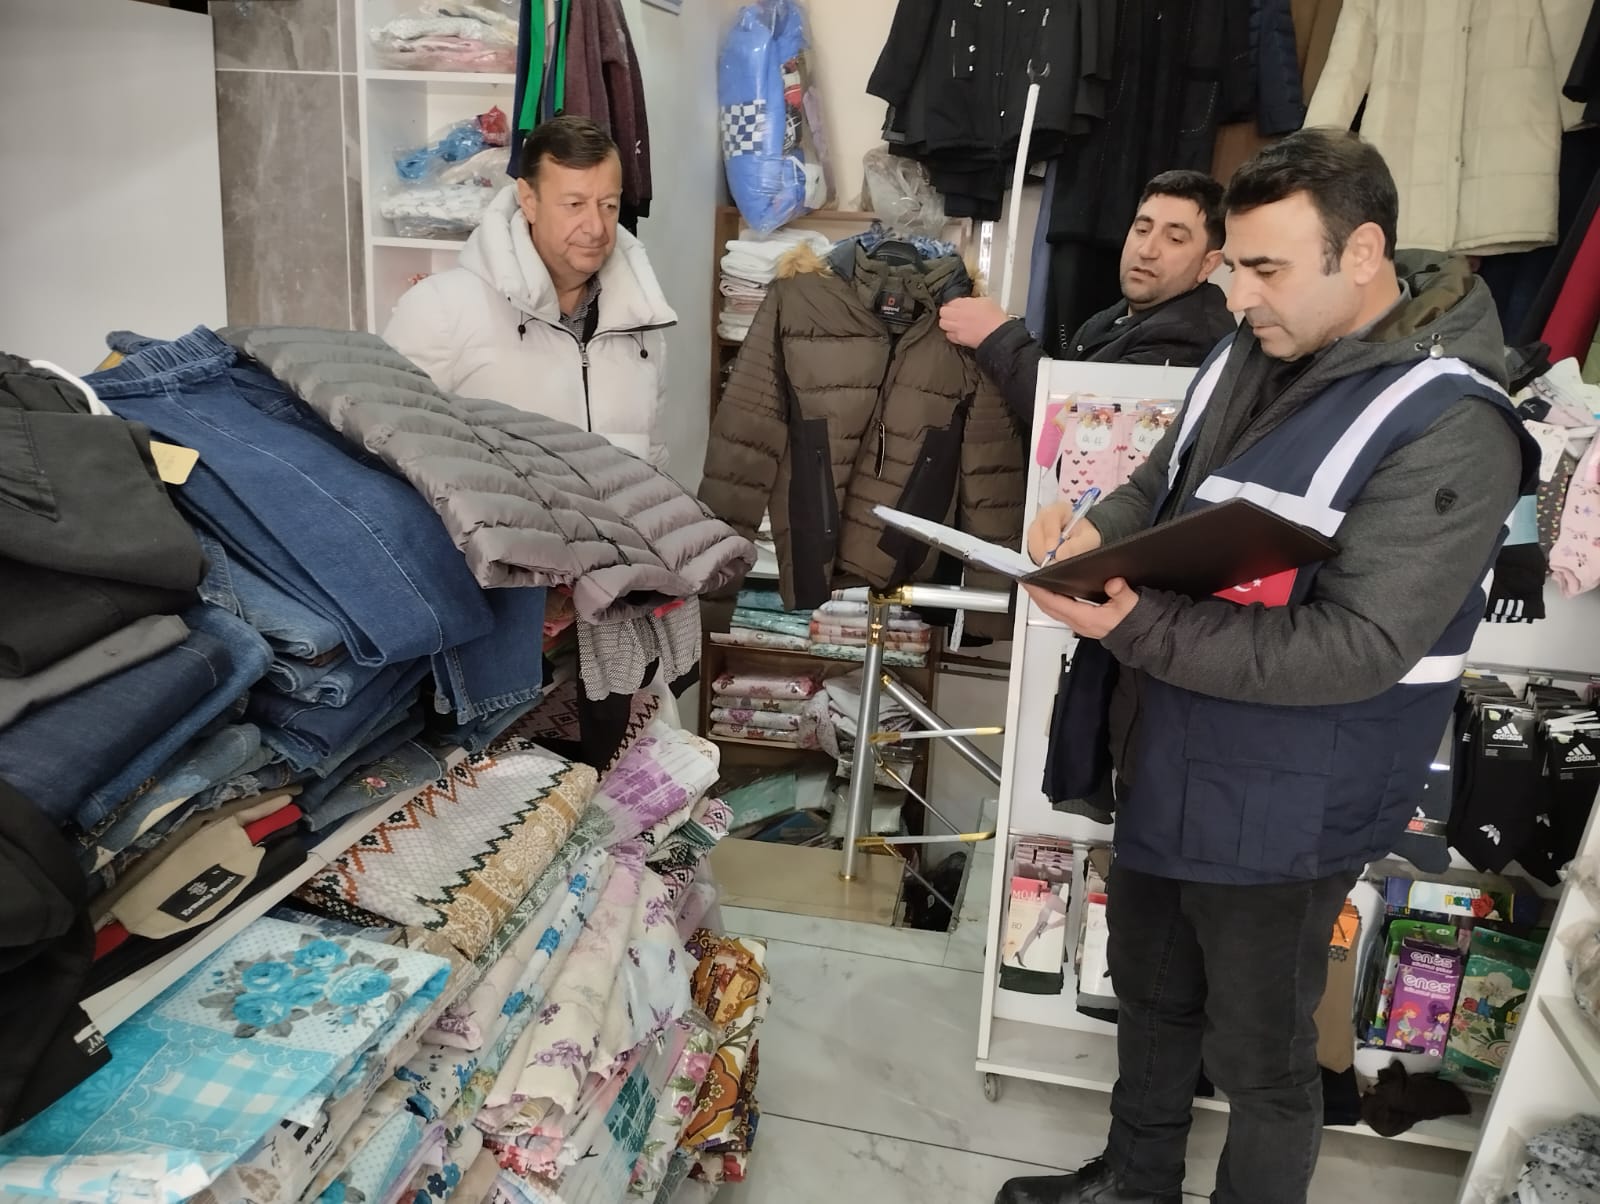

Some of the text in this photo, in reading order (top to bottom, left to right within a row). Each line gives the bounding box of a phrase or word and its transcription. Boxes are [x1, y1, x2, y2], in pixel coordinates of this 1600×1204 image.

[1492, 733, 1523, 741] adidas
[1565, 754, 1596, 763] adidas
[1410, 951, 1453, 969] enes
[1403, 974, 1452, 994] enes
